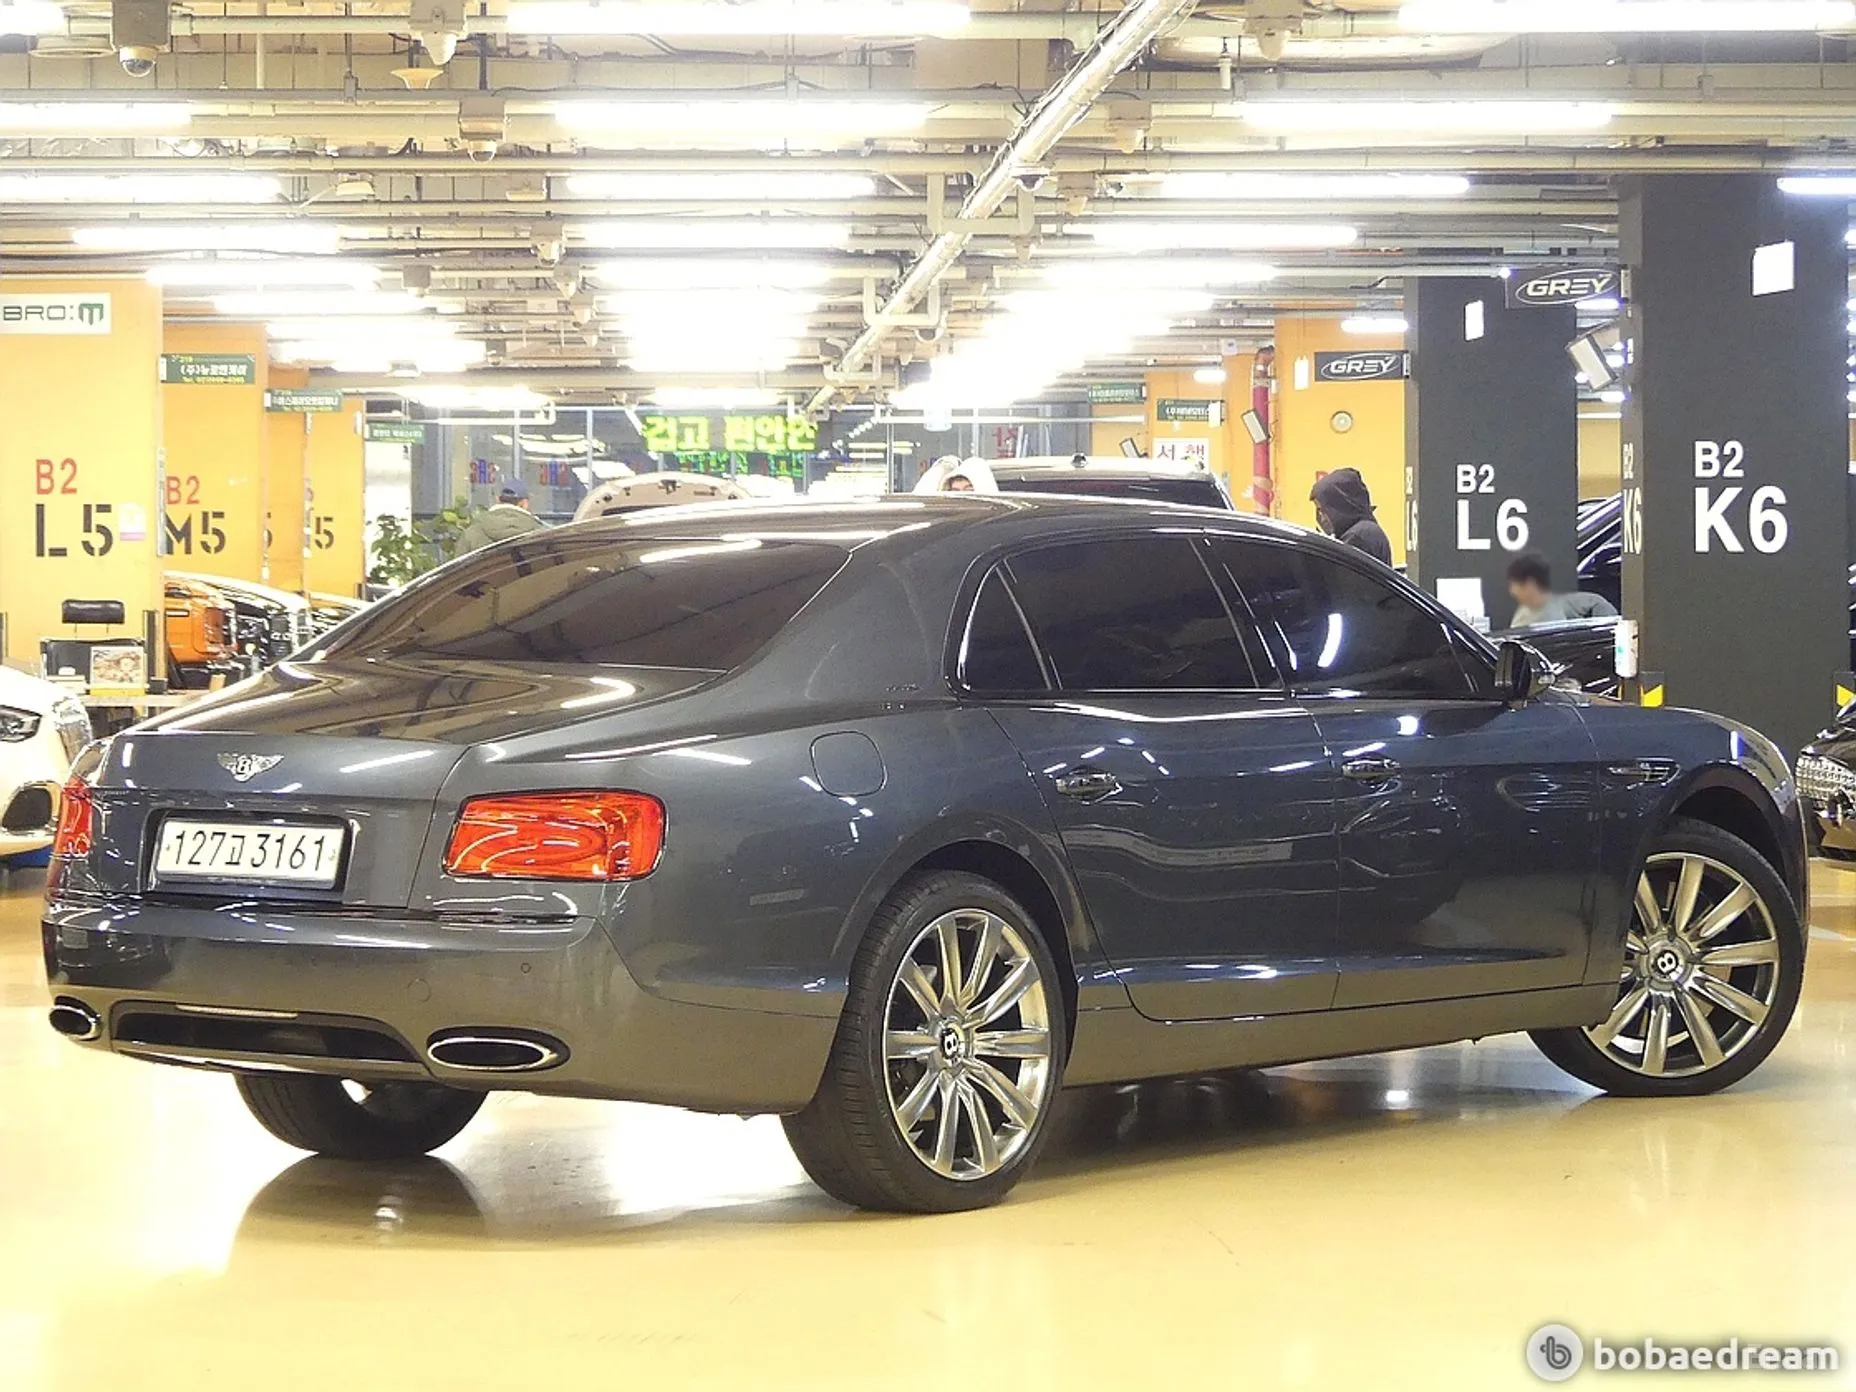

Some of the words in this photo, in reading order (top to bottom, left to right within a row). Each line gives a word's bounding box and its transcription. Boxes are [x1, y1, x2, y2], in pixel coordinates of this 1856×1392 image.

[1525, 272, 1613, 297] GREY
[1329, 354, 1399, 375] GREY
[36, 457, 78, 495] B2
[1456, 464, 1496, 494] B2
[1694, 441, 1745, 478] B2
[165, 475, 201, 505] B2
[36, 503, 114, 557] L5
[164, 510, 227, 555] M5
[1457, 497, 1530, 551] L6
[1623, 487, 1642, 555] K6
[1694, 484, 1789, 554] K6
[175, 829, 326, 872] 127고3161
